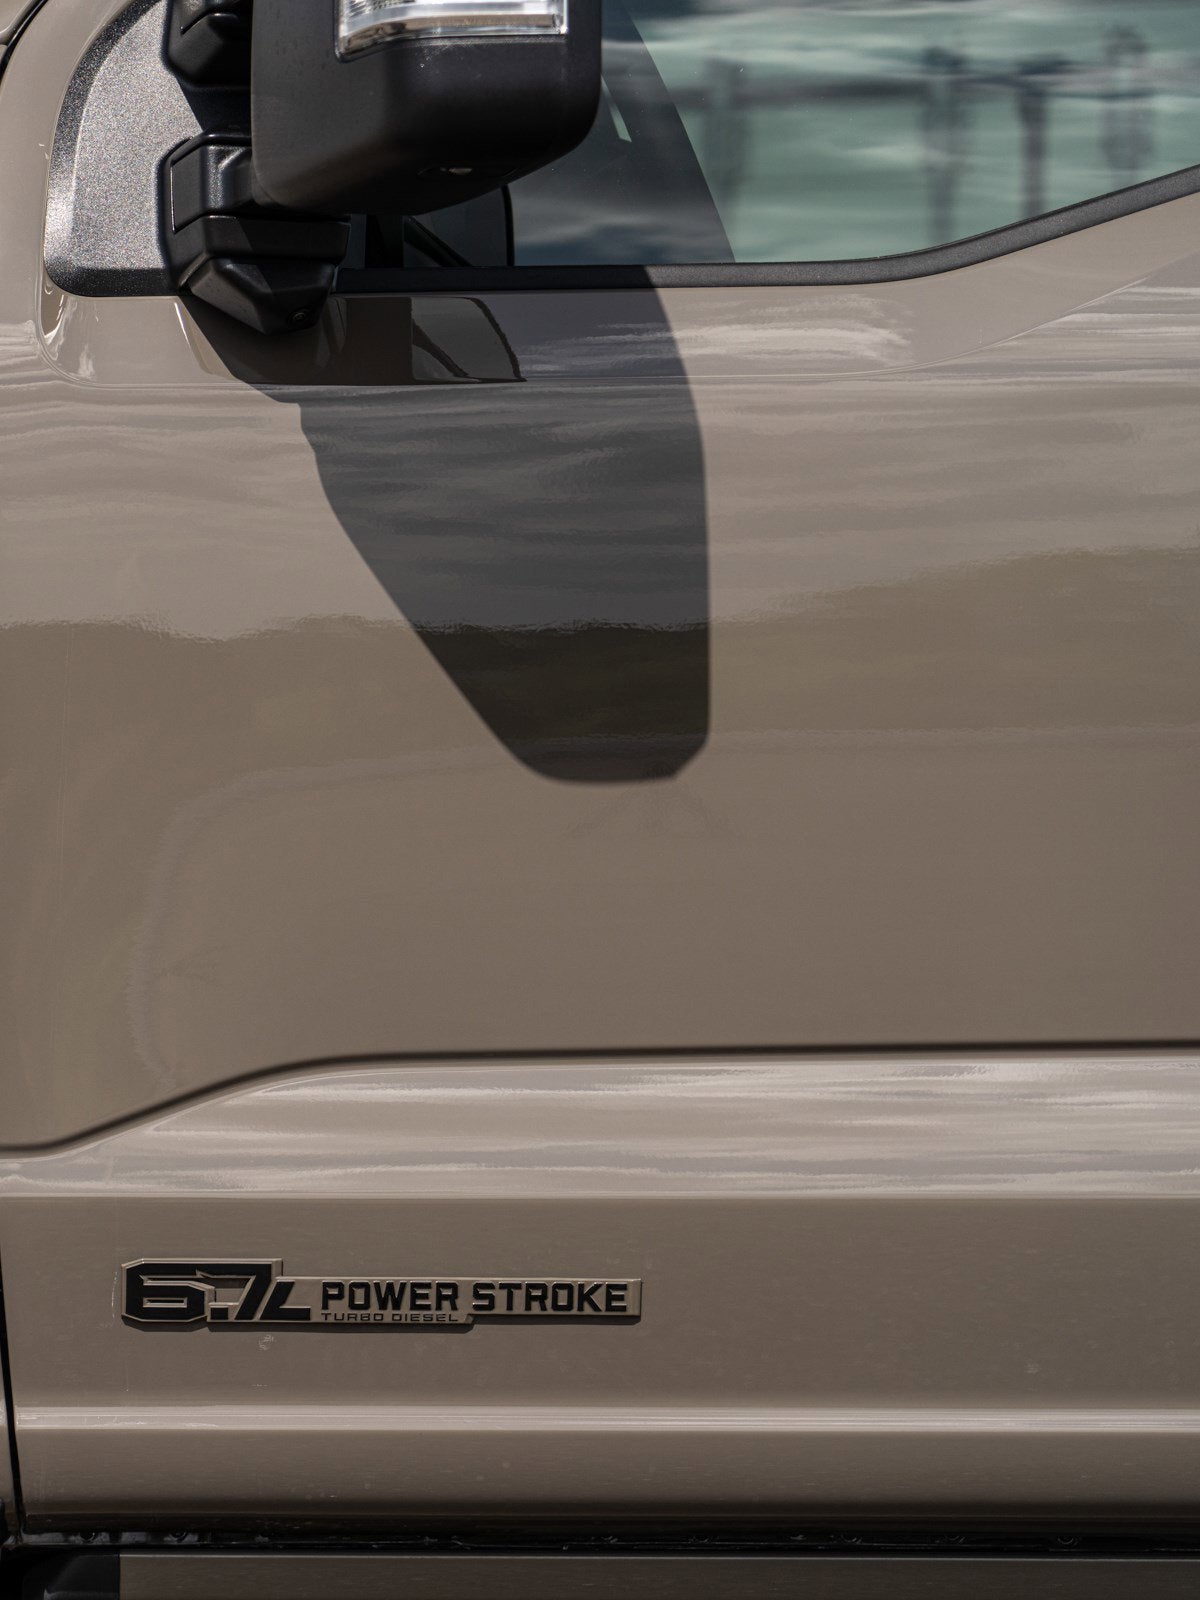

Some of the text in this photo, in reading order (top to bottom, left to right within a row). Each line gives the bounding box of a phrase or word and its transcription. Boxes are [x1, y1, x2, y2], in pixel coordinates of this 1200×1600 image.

[123, 1260, 628, 1321] 6.7L POWER STROKE
[321, 1312, 459, 1322] TURBO DIESEL
